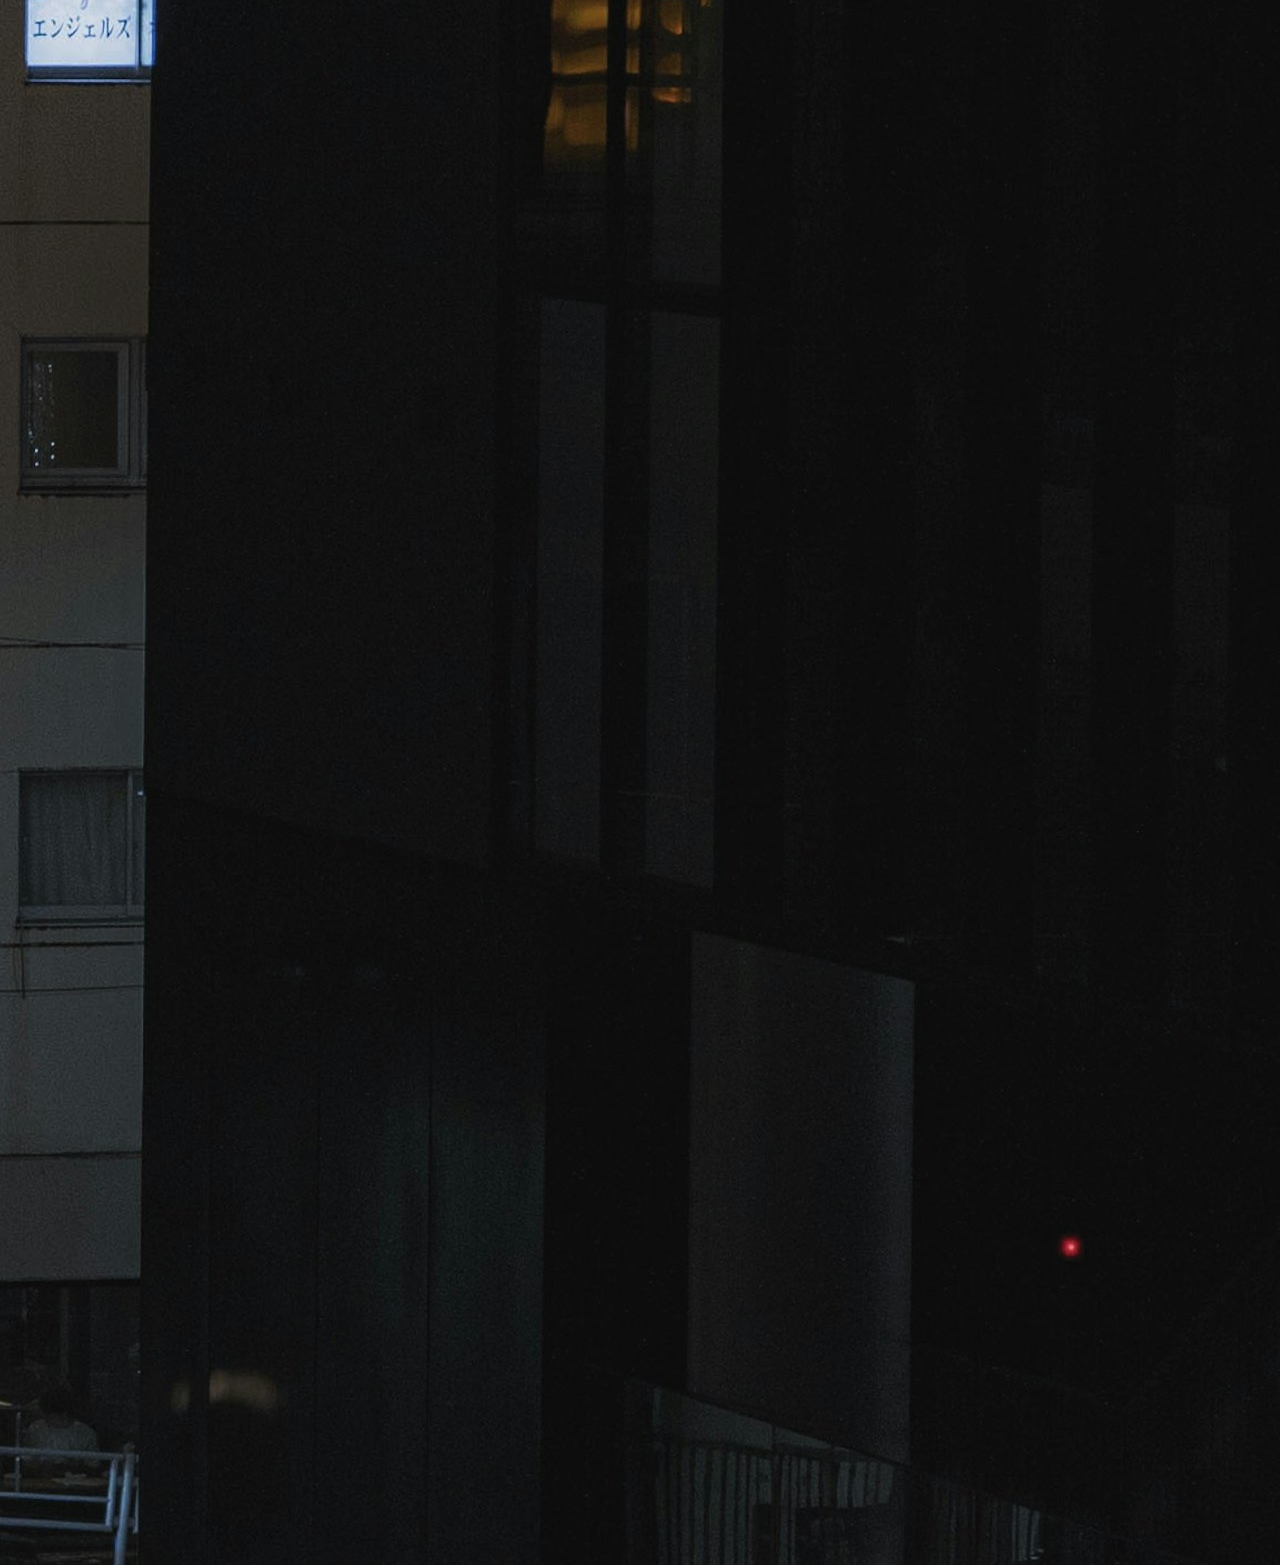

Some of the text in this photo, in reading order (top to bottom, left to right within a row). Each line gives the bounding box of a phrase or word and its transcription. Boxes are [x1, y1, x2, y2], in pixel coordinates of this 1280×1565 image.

[33, 16, 131, 39] エンジェルズ
